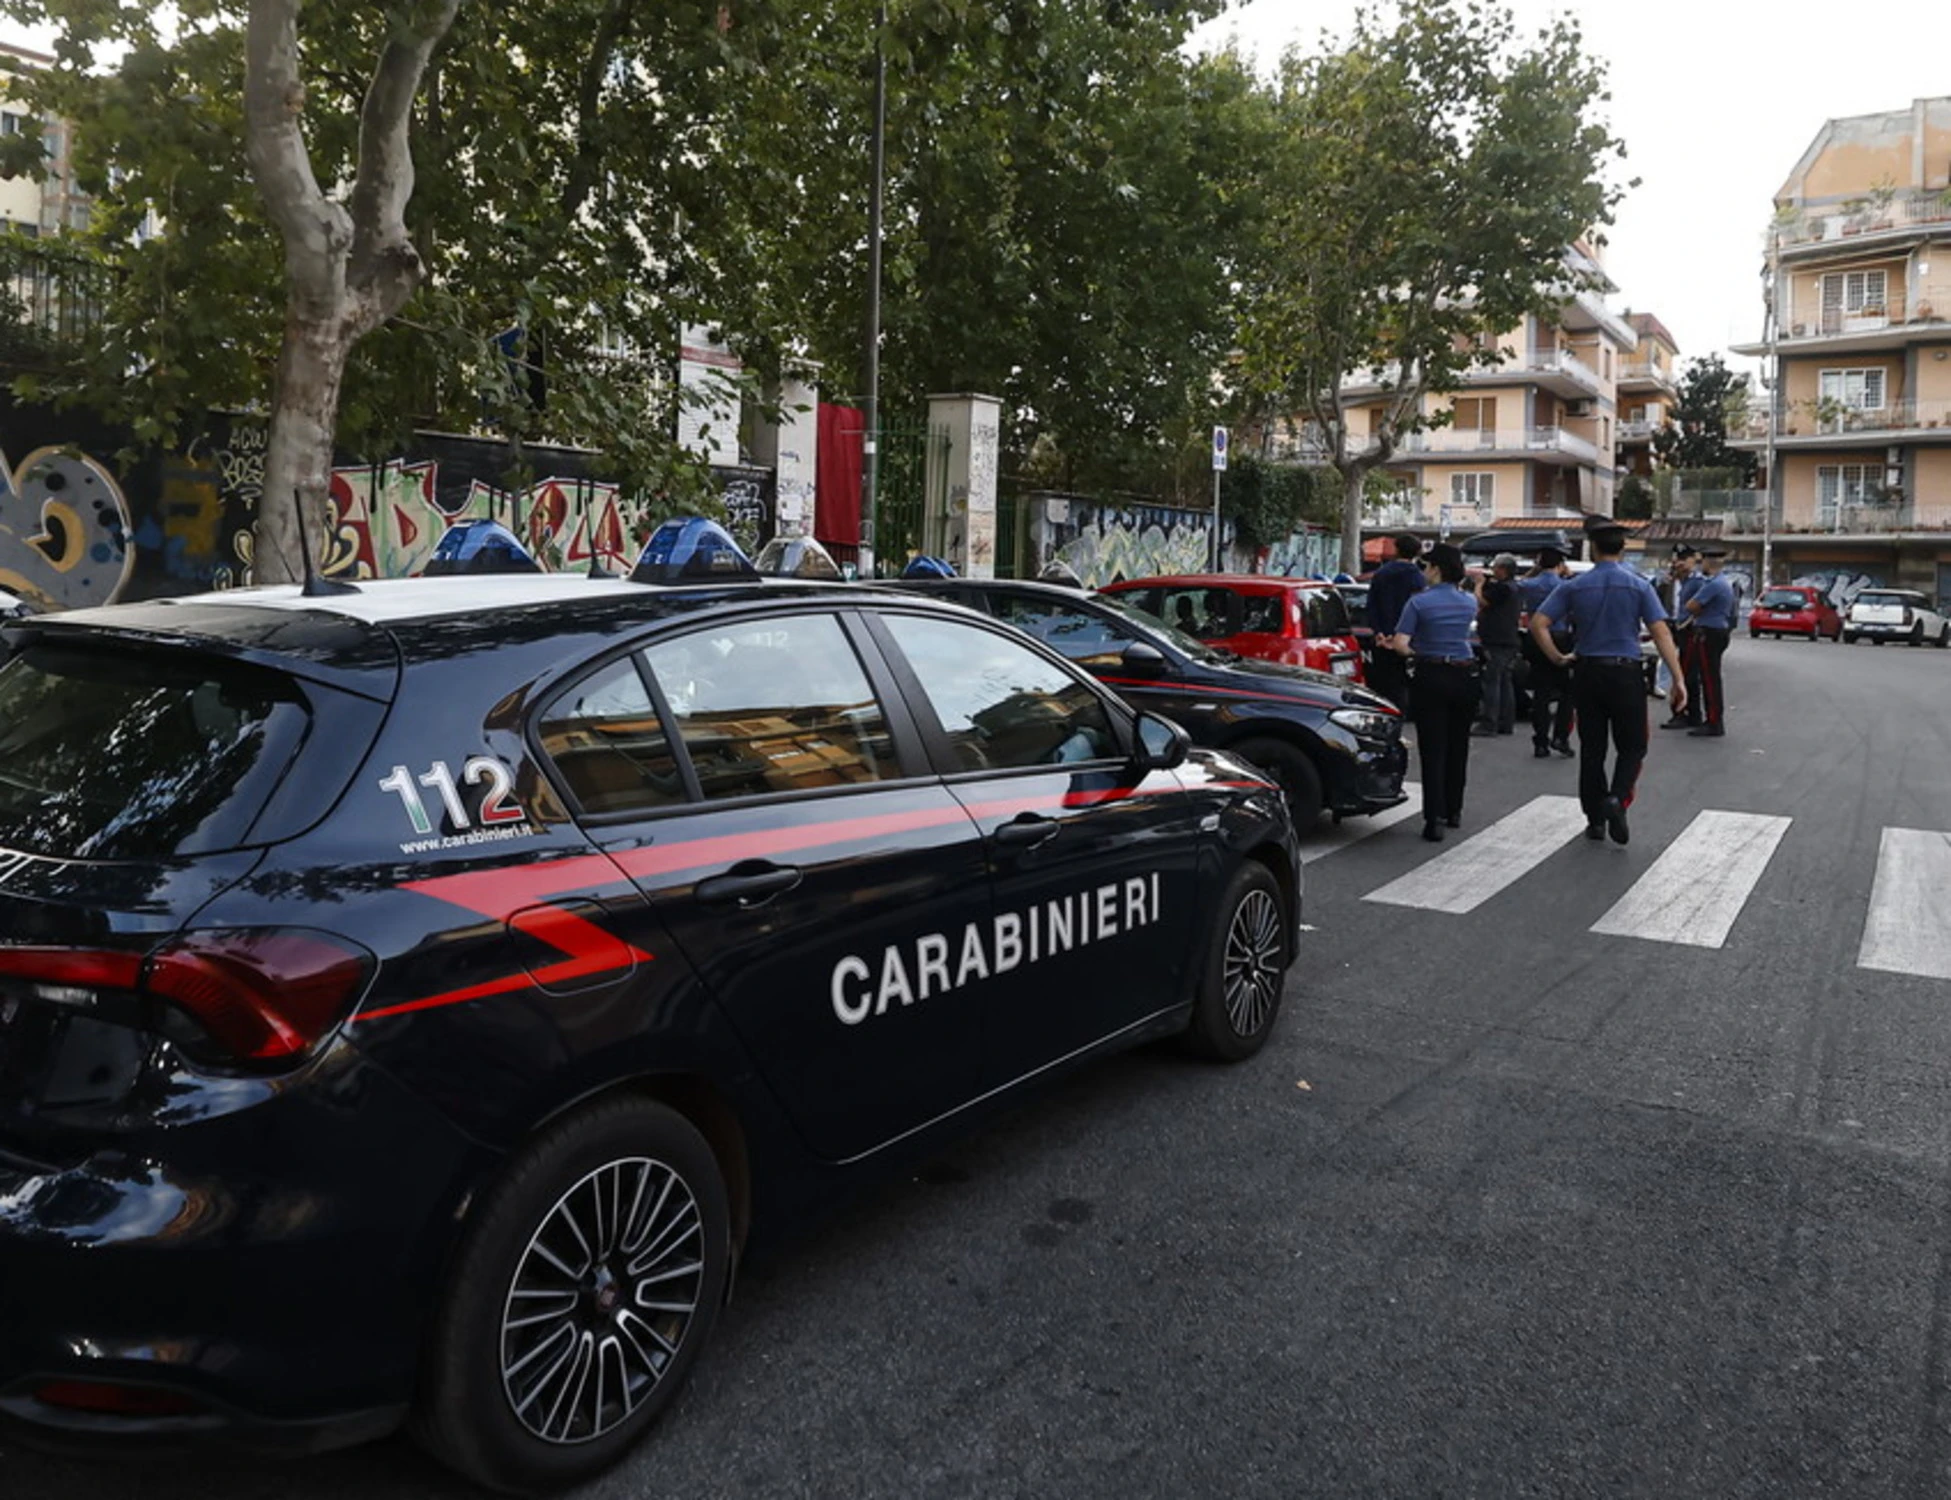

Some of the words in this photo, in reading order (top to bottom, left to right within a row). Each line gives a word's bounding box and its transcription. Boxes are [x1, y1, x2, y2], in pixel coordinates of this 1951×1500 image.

[379, 756, 524, 834] 112
[400, 824, 533, 854] www.carabinieri.it
[831, 872, 1159, 1025] CARABINIERI
